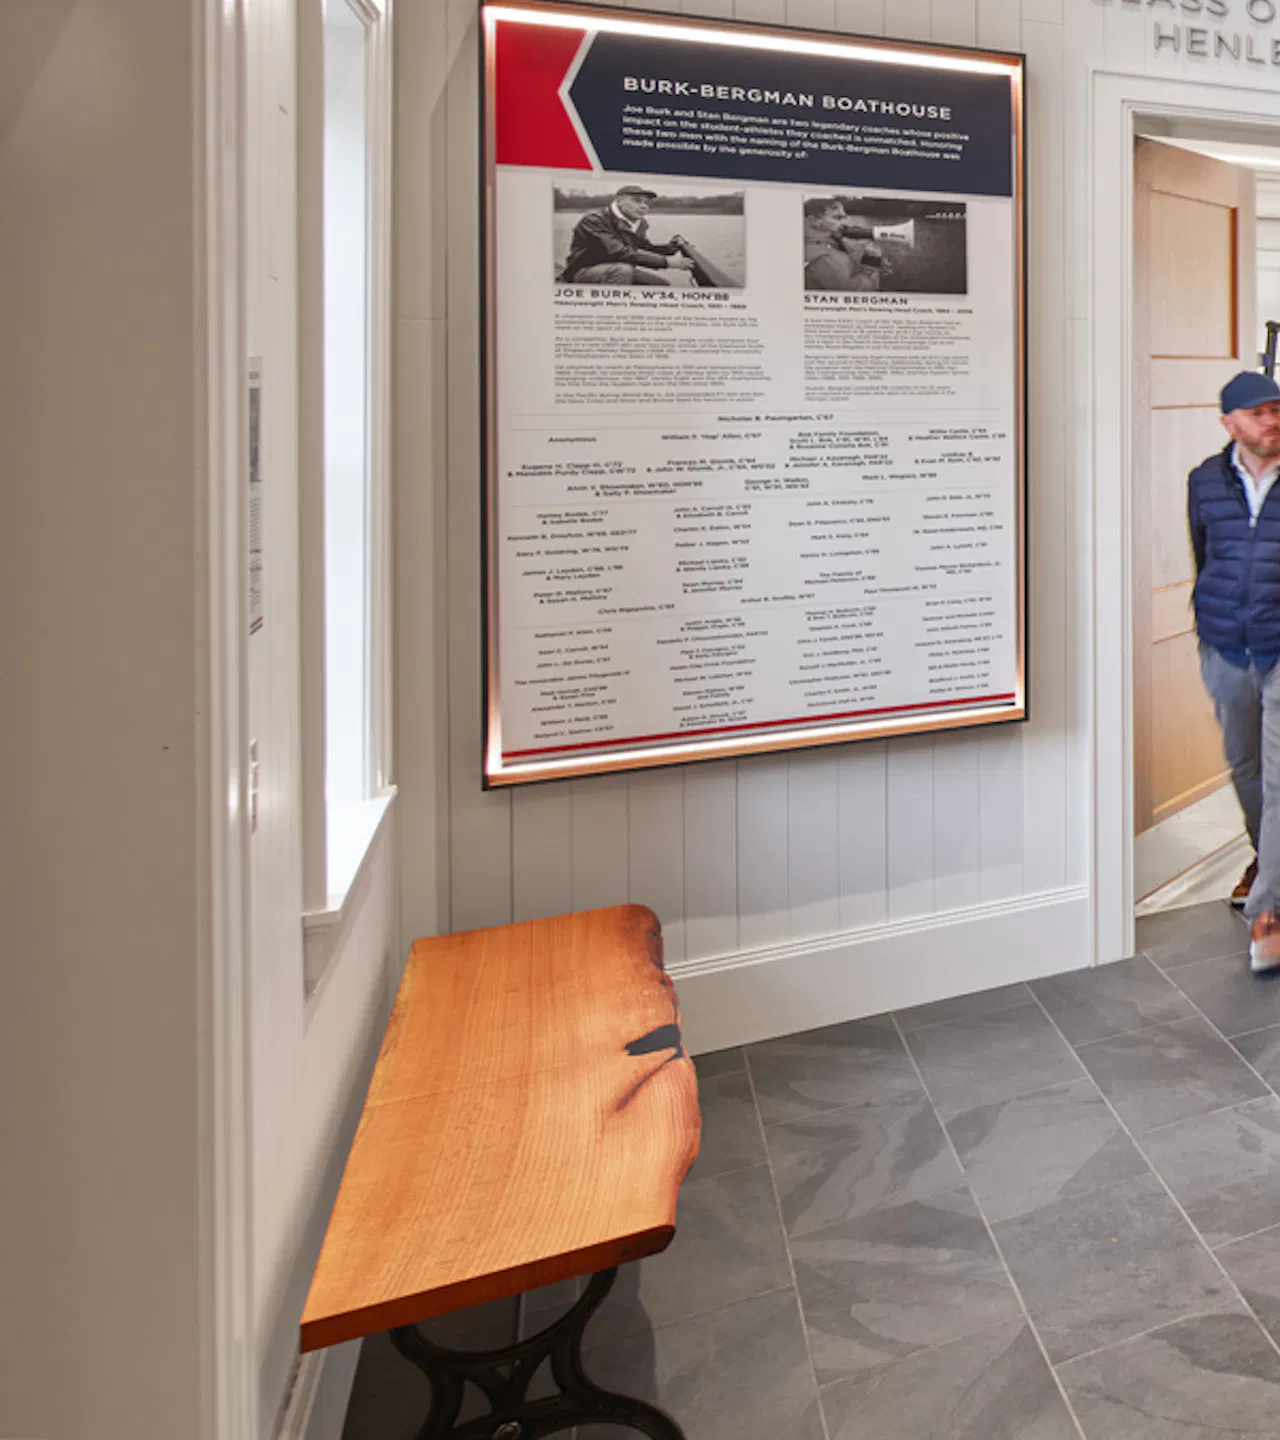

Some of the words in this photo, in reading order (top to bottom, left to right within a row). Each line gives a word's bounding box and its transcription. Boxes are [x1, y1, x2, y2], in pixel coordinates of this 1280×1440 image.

[623, 76, 815, 107] BURK-BERGMAN
[822, 95, 952, 121] BOATHOUSE
[622, 116, 661, 127] impact
[663, 120, 678, 128] on
[680, 120, 698, 129] the
[700, 121, 784, 136] student-athletes
[786, 127, 808, 139] they
[810, 131, 851, 141] coached
[920, 140, 963, 152] Honoring
[623, 105, 644, 113] Joe
[646, 106, 671, 116] Burk
[673, 109, 695, 118] and
[697, 110, 721, 120] Stan
[722, 112, 769, 124] Bergman
[772, 118, 788, 126] are
[811, 120, 860, 133] legendary
[861, 124, 900, 136] coaches
[902, 127, 932, 138] whose
[933, 130, 970, 142] positive
[622, 127, 653, 137] these
[656, 130, 677, 139] two
[678, 132, 703, 140] men
[705, 132, 728, 142] with
[730, 135, 748, 144] the
[749, 136, 788, 148] naming
[789, 139, 801, 148] of
[801, 140, 819, 150] the
[821, 142, 890, 155] Burk-Bergman
[891, 147, 941, 159] Boathouse
[622, 139, 654, 148] made
[656, 142, 701, 153] possible
[703, 144, 718, 155] by
[719, 145, 737, 154] the
[738, 147, 793, 160] generosity
[554, 288, 584, 298] JOE
[590, 289, 637, 301] BURK,
[804, 295, 839, 304] STAN
[844, 296, 908, 305] BERGMAN
